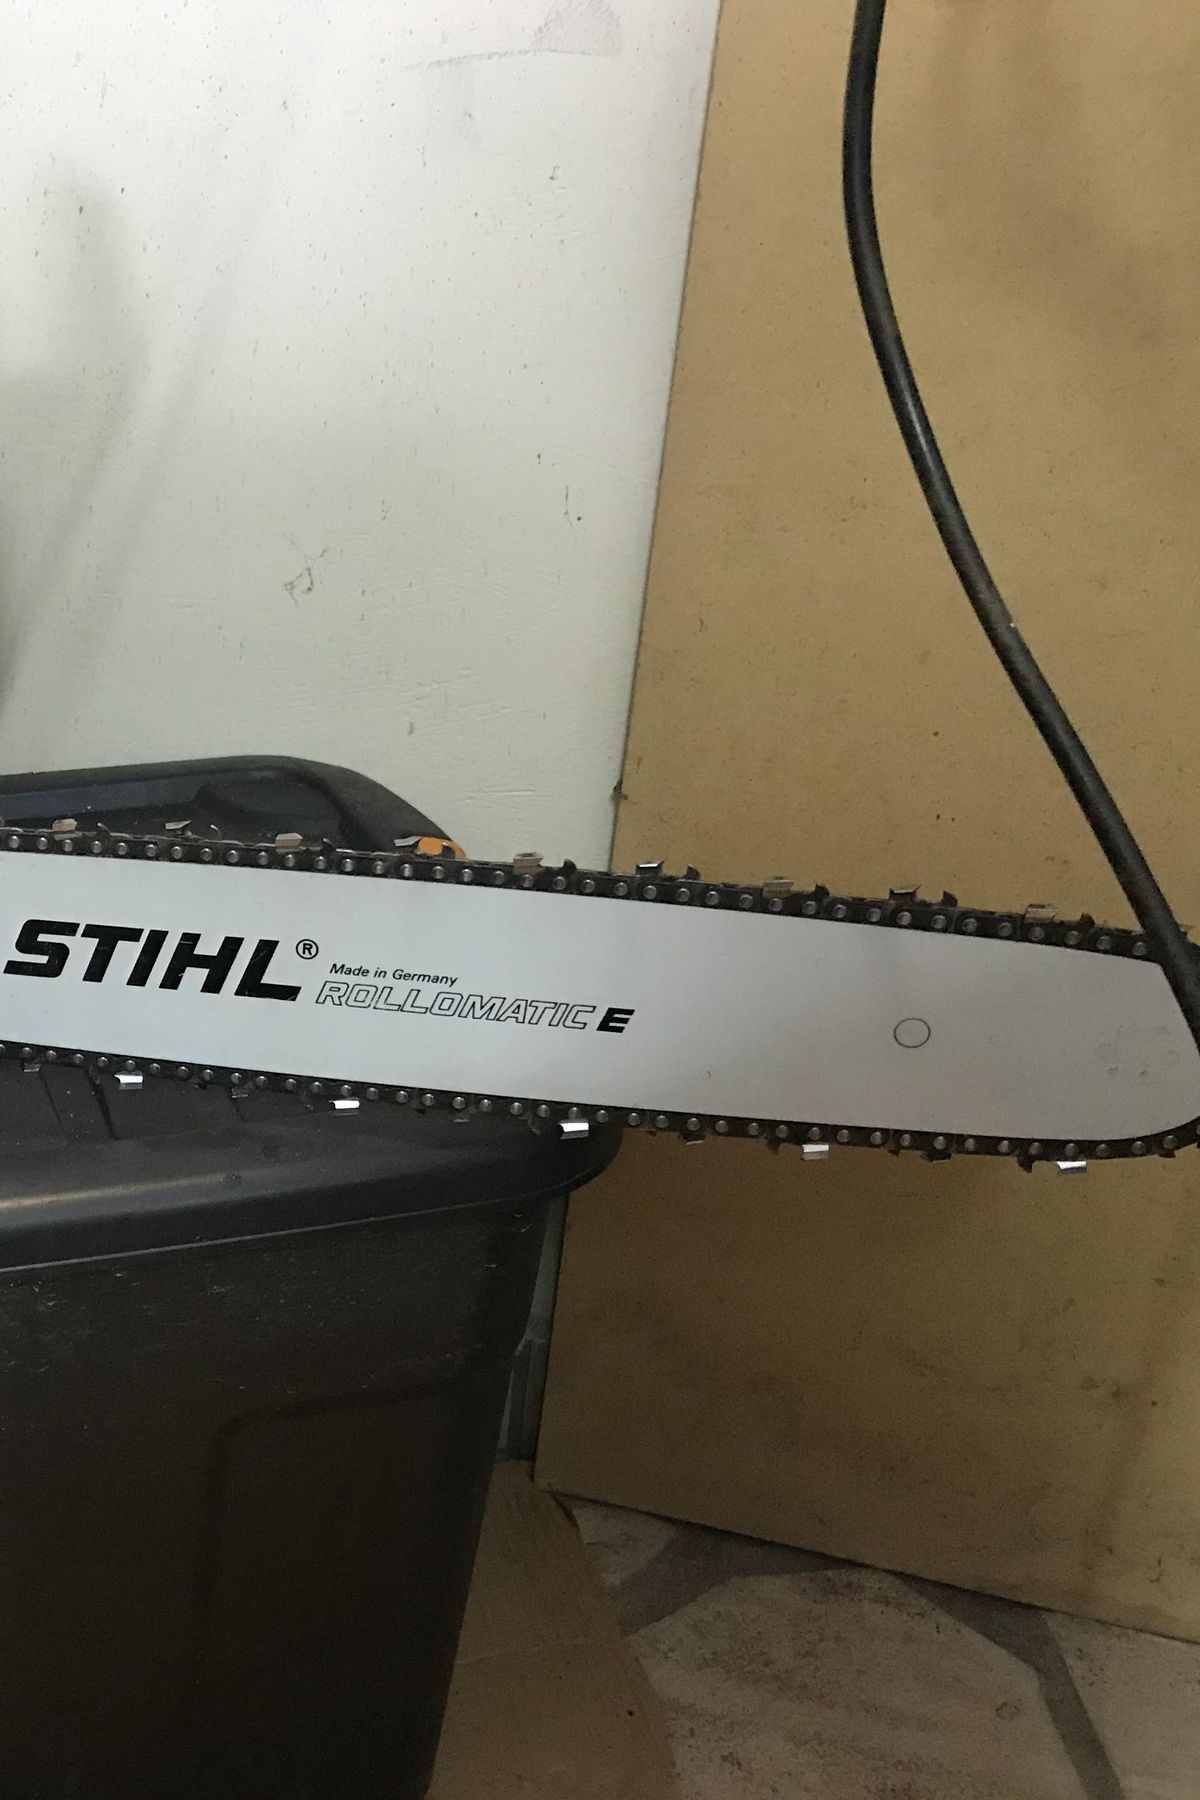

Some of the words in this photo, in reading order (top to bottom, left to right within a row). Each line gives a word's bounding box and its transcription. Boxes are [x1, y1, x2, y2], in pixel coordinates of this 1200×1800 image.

[329, 963, 370, 977] Made
[373, 966, 388, 979] in
[392, 968, 459, 987] Germany
[315, 980, 597, 1030] ROLLOMATIC
[596, 1007, 636, 1034] E
